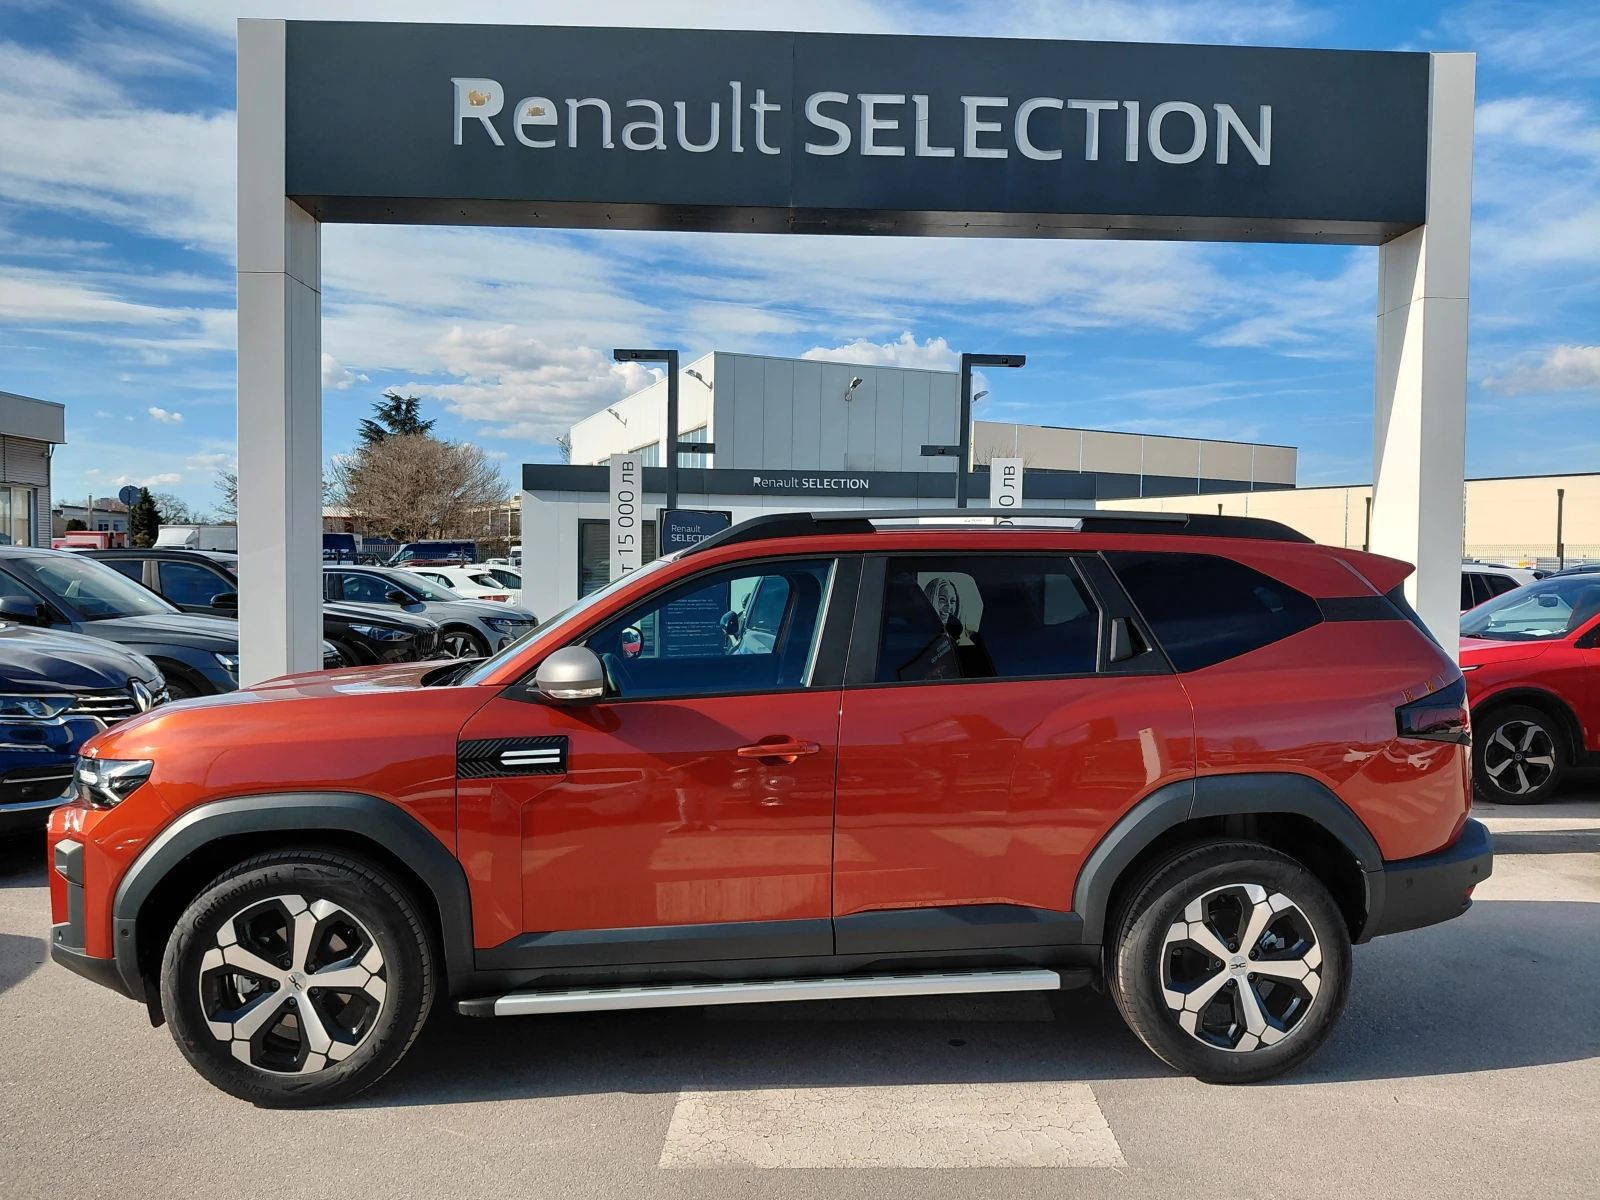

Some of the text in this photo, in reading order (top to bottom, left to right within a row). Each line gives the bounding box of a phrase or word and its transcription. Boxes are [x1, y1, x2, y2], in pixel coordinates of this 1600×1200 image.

[451, 77, 1273, 166] Renault SELECTION
[753, 476, 869, 489] Renault SELECTION
[617, 491, 635, 528] 000
[671, 524, 701, 533] Renault
[671, 534, 711, 543] SELECTIO
[617, 535, 635, 556] 15
[192, 873, 269, 931] Continental
